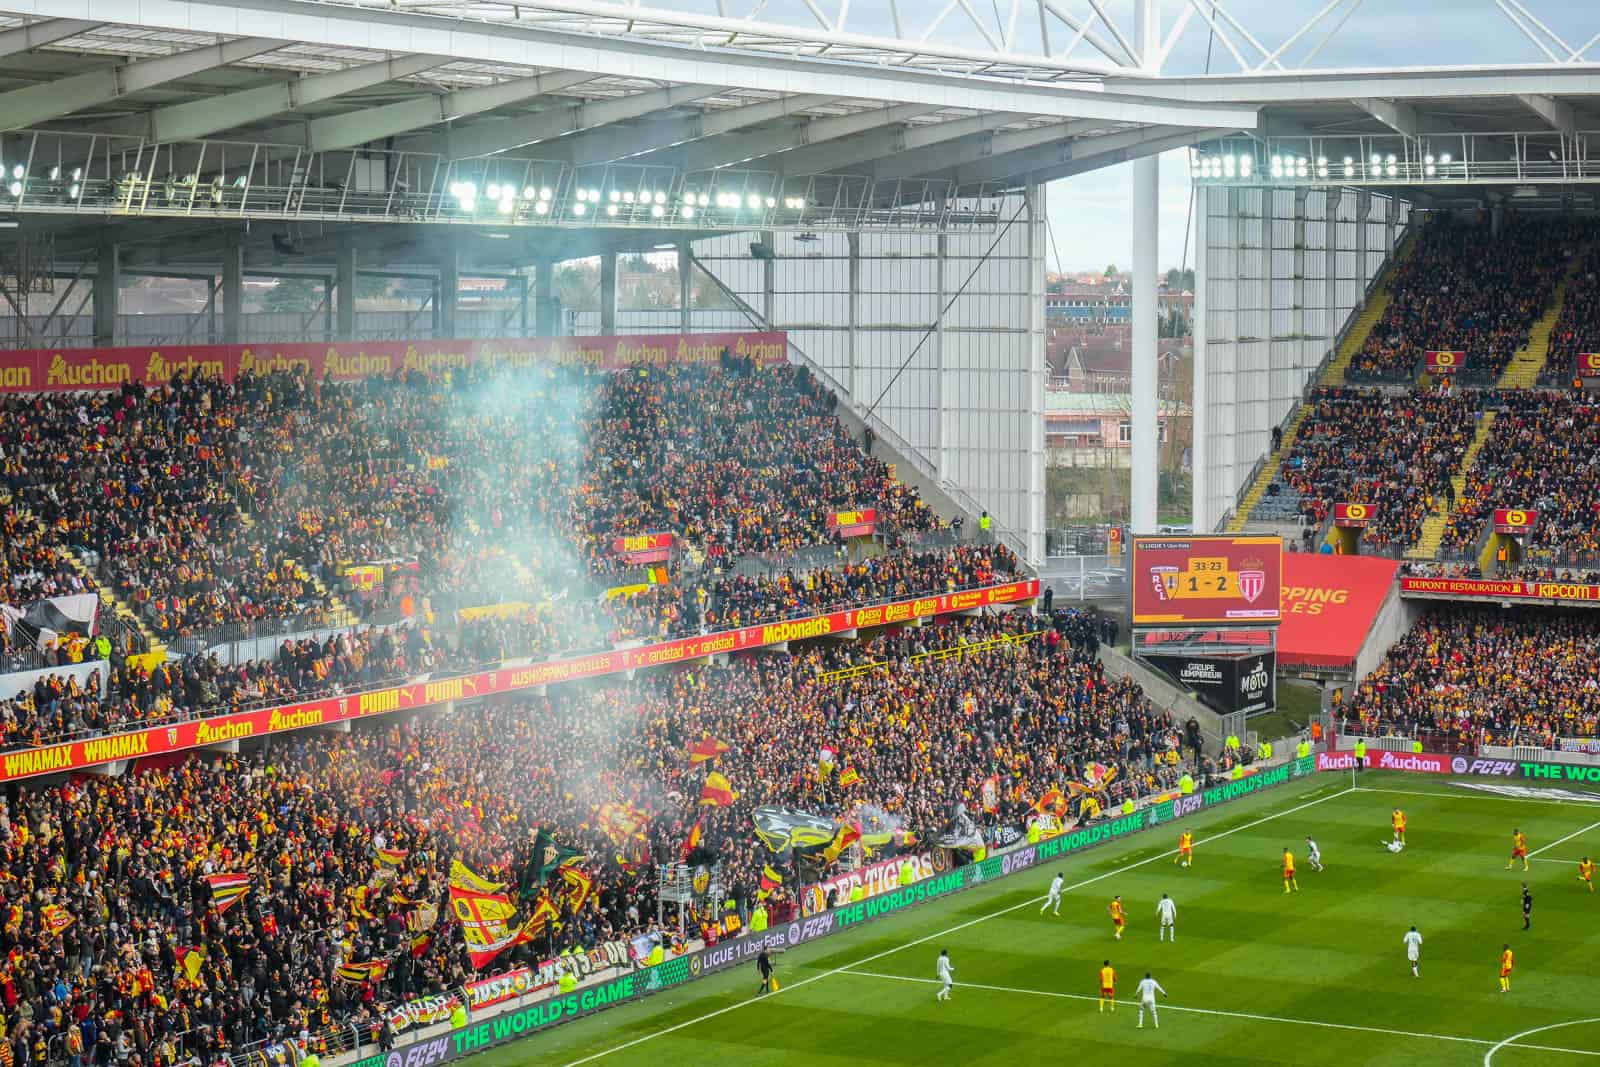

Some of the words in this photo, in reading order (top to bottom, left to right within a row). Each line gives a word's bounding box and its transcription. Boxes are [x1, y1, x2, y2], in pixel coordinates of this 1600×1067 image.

[615, 340, 667, 363] Auchan
[736, 335, 783, 358] Auchan
[48, 354, 131, 384] Auchan
[323, 347, 391, 374] Auchan
[1194, 562, 1222, 571] 33:23
[1189, 577, 1199, 592] 1
[1216, 576, 1228, 592] 2
[1408, 580, 1448, 591] DUPONT
[1450, 582, 1511, 593] RESTAURATION
[763, 617, 831, 644] McDonald's
[648, 644, 684, 662] randstad
[701, 635, 735, 653] randstad
[1241, 671, 1268, 693] MOTO
[360, 689, 400, 714] PUMA
[196, 721, 253, 743] Auchan
[269, 709, 323, 732] Auchan
[84, 733, 148, 762] WINAMAX
[5, 746, 73, 777] WINAMAX
[1380, 752, 1440, 771] Auchan
[1520, 763, 1562, 779] THE
[1203, 786, 1222, 805] THE
[1223, 774, 1262, 800] WORLD'S
[1263, 768, 1289, 785] GAME
[1038, 840, 1059, 859] THE
[1060, 823, 1110, 851] WORLD'S
[1111, 811, 1143, 836] GAME
[864, 852, 935, 897] TIGRS
[835, 902, 865, 928] THE
[866, 883, 925, 919] WORLD'S
[926, 870, 964, 898] GAME
[704, 946, 734, 968] LIGUE
[736, 944, 741, 957] 1
[743, 940, 763, 954] Uber
[453, 1021, 490, 1053] THE
[492, 995, 579, 1040] WORLD'S
[580, 975, 636, 1012] GAME
